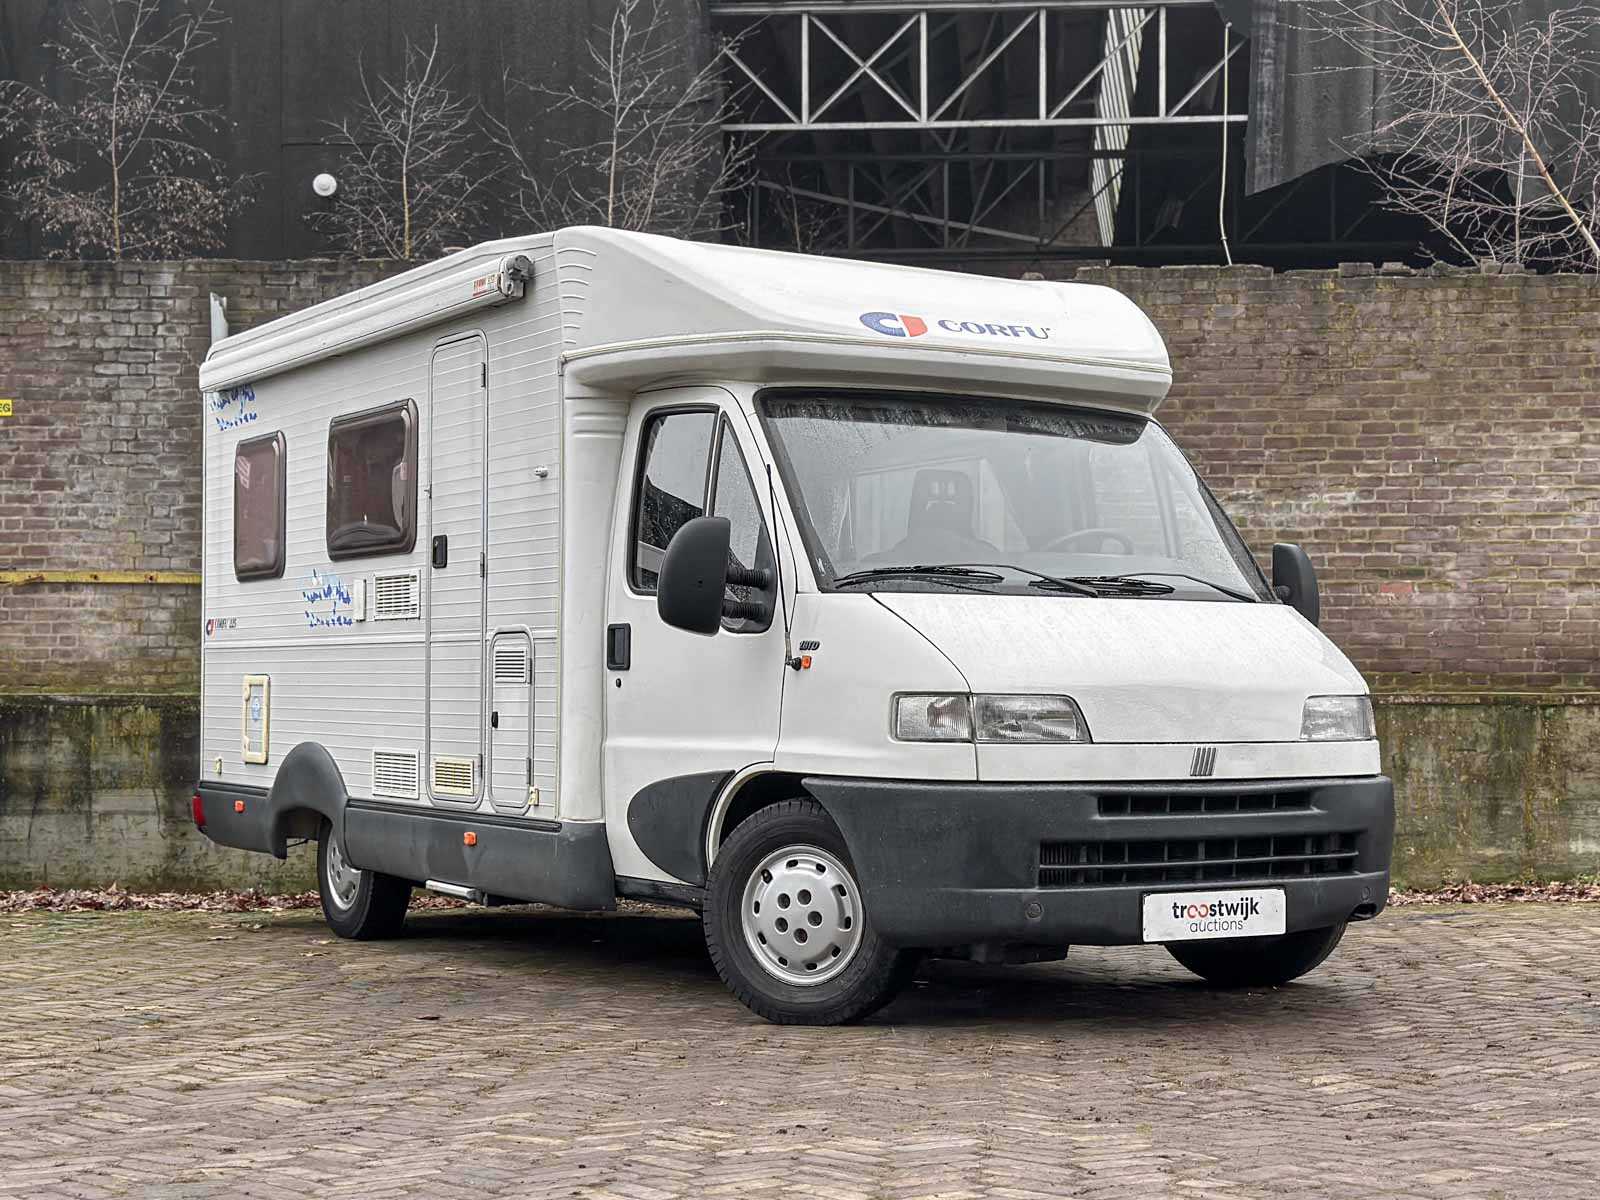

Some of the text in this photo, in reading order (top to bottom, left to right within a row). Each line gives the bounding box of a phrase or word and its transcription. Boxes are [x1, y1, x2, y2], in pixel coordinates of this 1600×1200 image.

[937, 319, 1049, 340] CORFU
[1172, 897, 1260, 920] troostwijk
[1189, 918, 1243, 933] auctions
